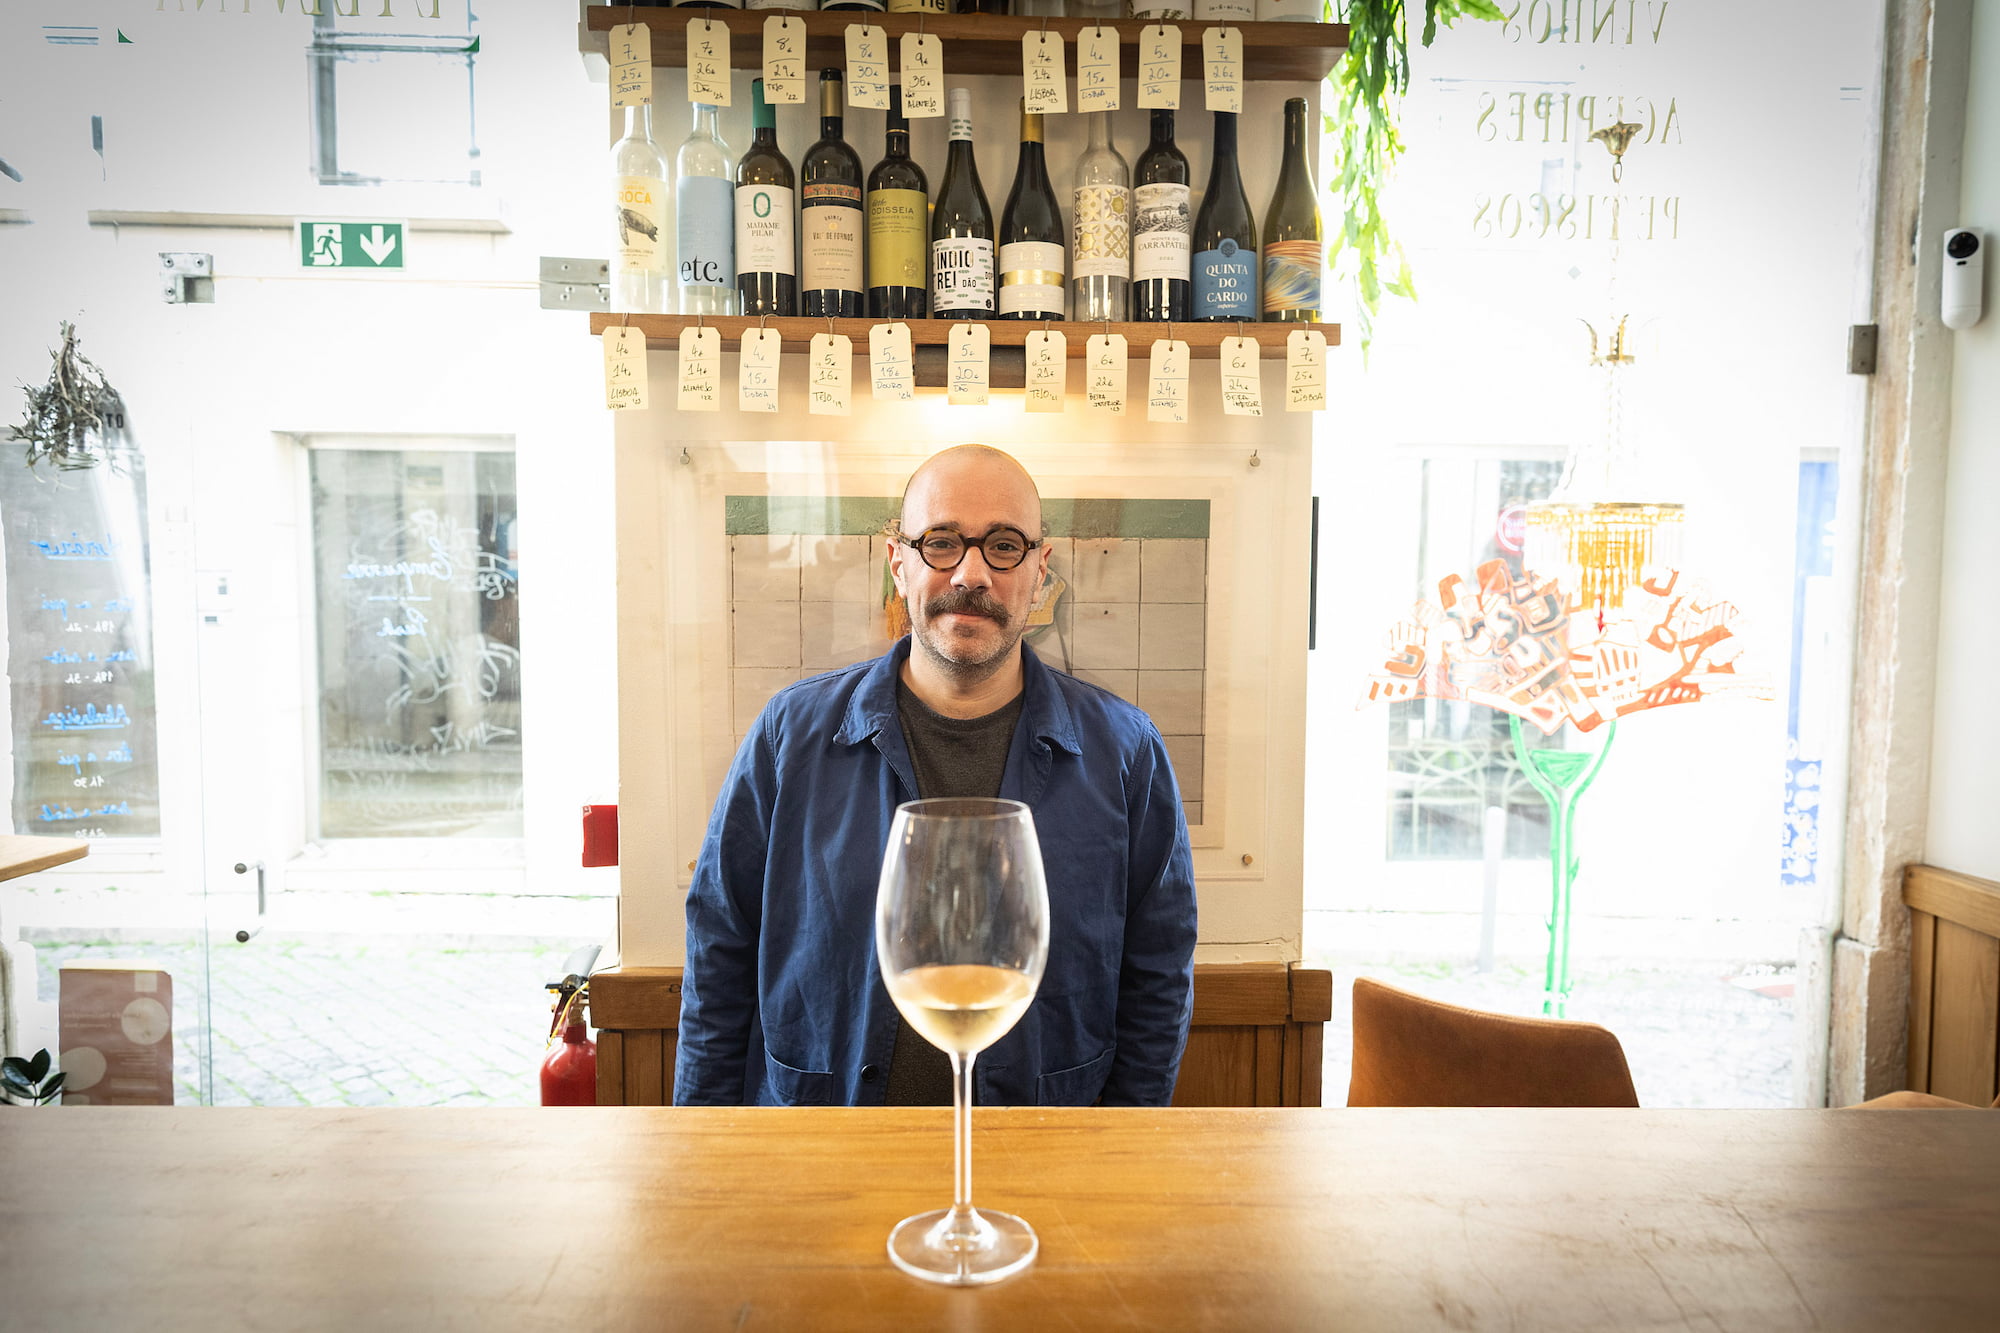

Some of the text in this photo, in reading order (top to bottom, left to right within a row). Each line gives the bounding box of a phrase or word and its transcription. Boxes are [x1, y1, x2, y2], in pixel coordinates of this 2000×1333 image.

[871, 206, 914, 216] ODISSEIA
[746, 222, 781, 230] MADAME
[751, 229, 774, 238] PILAR
[936, 247, 974, 270] ÍNDIO
[681, 255, 725, 283] etc.
[1206, 264, 1248, 278] QUINTA
[937, 271, 957, 290] REI
[962, 277, 977, 288] DÃO
[1218, 278, 1237, 288] DO
[1207, 292, 1248, 303] CARDO
